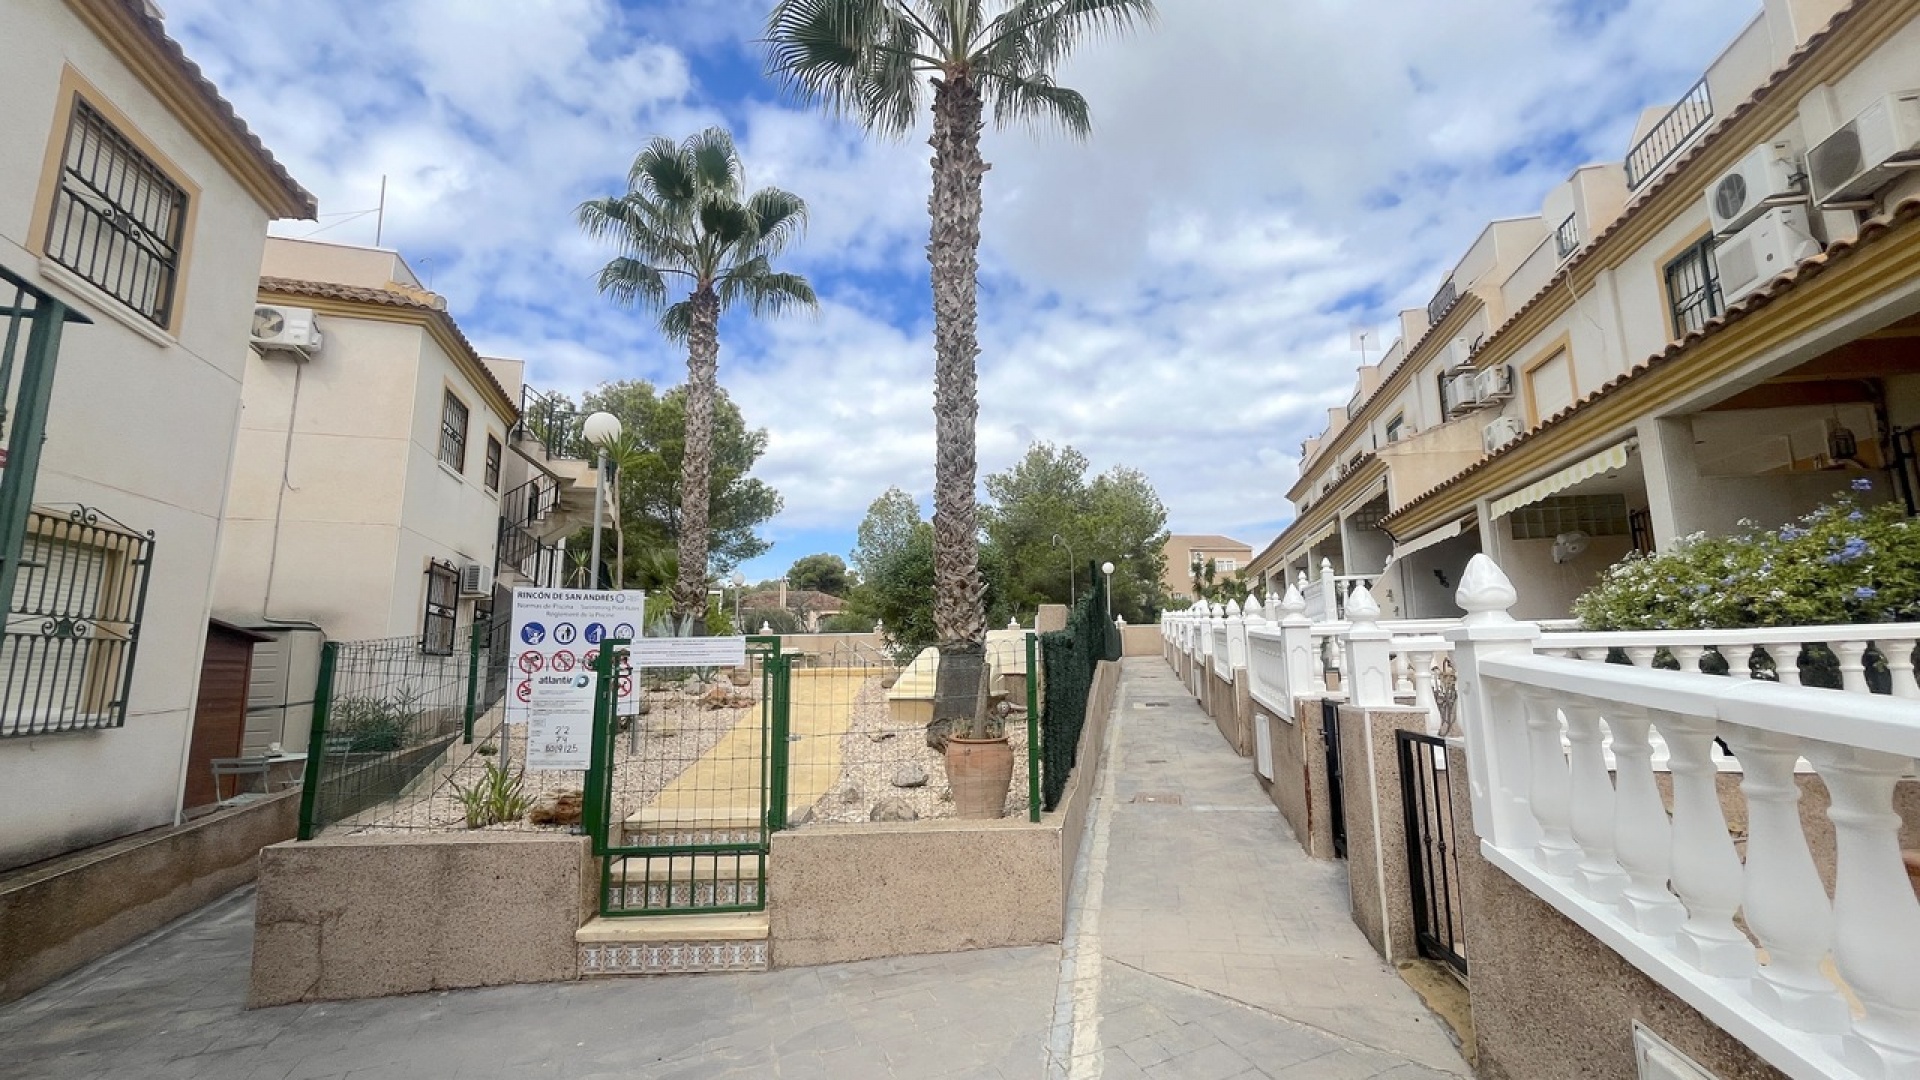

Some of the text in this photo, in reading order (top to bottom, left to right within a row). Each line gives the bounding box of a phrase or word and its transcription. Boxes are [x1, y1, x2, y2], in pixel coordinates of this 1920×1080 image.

[517, 591, 551, 600] RINCÓN
[565, 593, 581, 601] SAN
[583, 593, 614, 601] ANDRÉS
